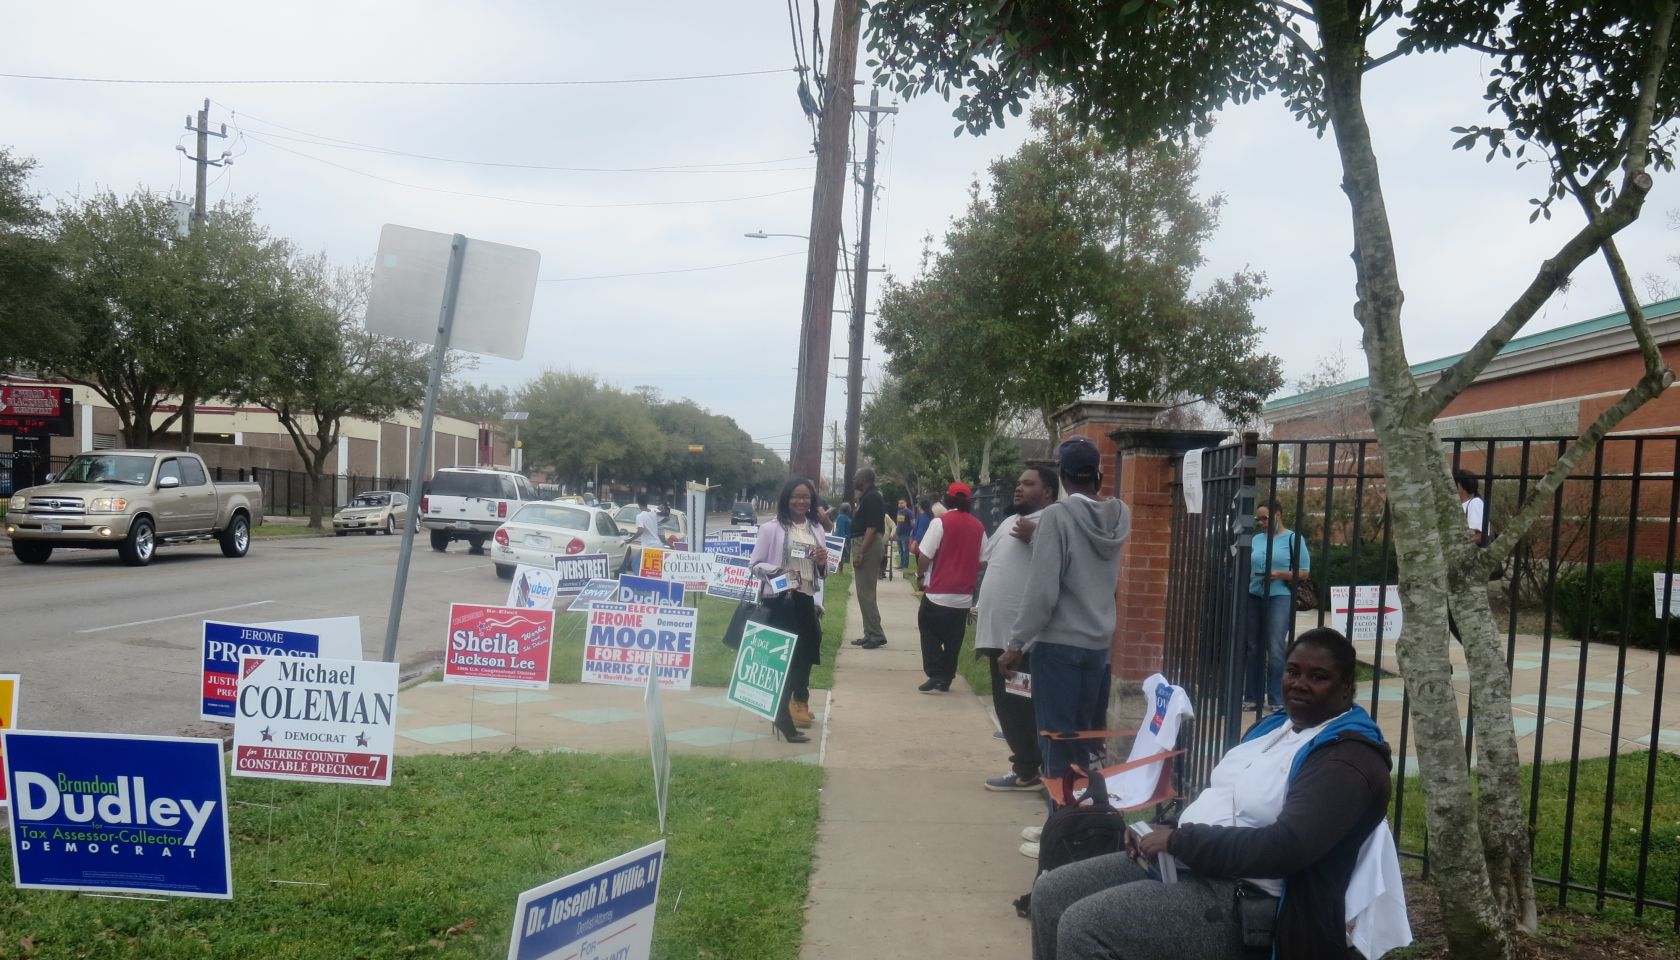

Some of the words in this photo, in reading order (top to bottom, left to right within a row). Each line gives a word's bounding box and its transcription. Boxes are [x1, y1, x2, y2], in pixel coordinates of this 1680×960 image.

[643, 557, 662, 570] LE
[675, 553, 700, 561] Michael
[557, 559, 606, 580] OVERSTREET
[663, 562, 713, 574] COLEMAN
[724, 566, 745, 577] Kelli
[724, 575, 759, 589] Johnson
[620, 586, 681, 607] Dudley
[628, 604, 659, 615] ELECT
[591, 611, 643, 628] JEROME
[657, 618, 693, 629] Democrat
[240, 629, 284, 644] JEROME
[452, 629, 519, 655] Sheila
[588, 625, 692, 653] MOORE
[750, 634, 770, 650] JUDGE
[207, 640, 316, 663] PROV
[594, 647, 623, 661] FOR
[245, 661, 260, 675] ELECT
[450, 652, 505, 668] Jackson
[509, 656, 535, 670] Lee
[585, 660, 633, 675] HARRIS
[737, 645, 784, 694] GREEN
[207, 675, 240, 687] JUSTIC
[278, 660, 355, 686] Michael
[239, 684, 395, 727] COLEMAN
[284, 730, 347, 744] DEMOCRAT
[246, 747, 258, 758] for
[263, 748, 304, 761] HARRIS
[305, 752, 349, 764] COUNTY
[239, 757, 309, 773] CONSTABLE
[310, 763, 370, 777] PRECINCT
[368, 756, 382, 777] 7
[57, 772, 118, 795] Brandon
[14, 770, 217, 847] Dudley
[91, 821, 103, 830] for
[20, 825, 47, 839] Tax
[52, 827, 184, 846] Assessor-Collector
[21, 840, 197, 859] DEMOCRAT
[525, 905, 546, 938] Dr.
[547, 882, 598, 929] Joseph
[597, 877, 609, 906] R.
[611, 864, 646, 900] Willie,
[593, 943, 632, 960] UNTY
